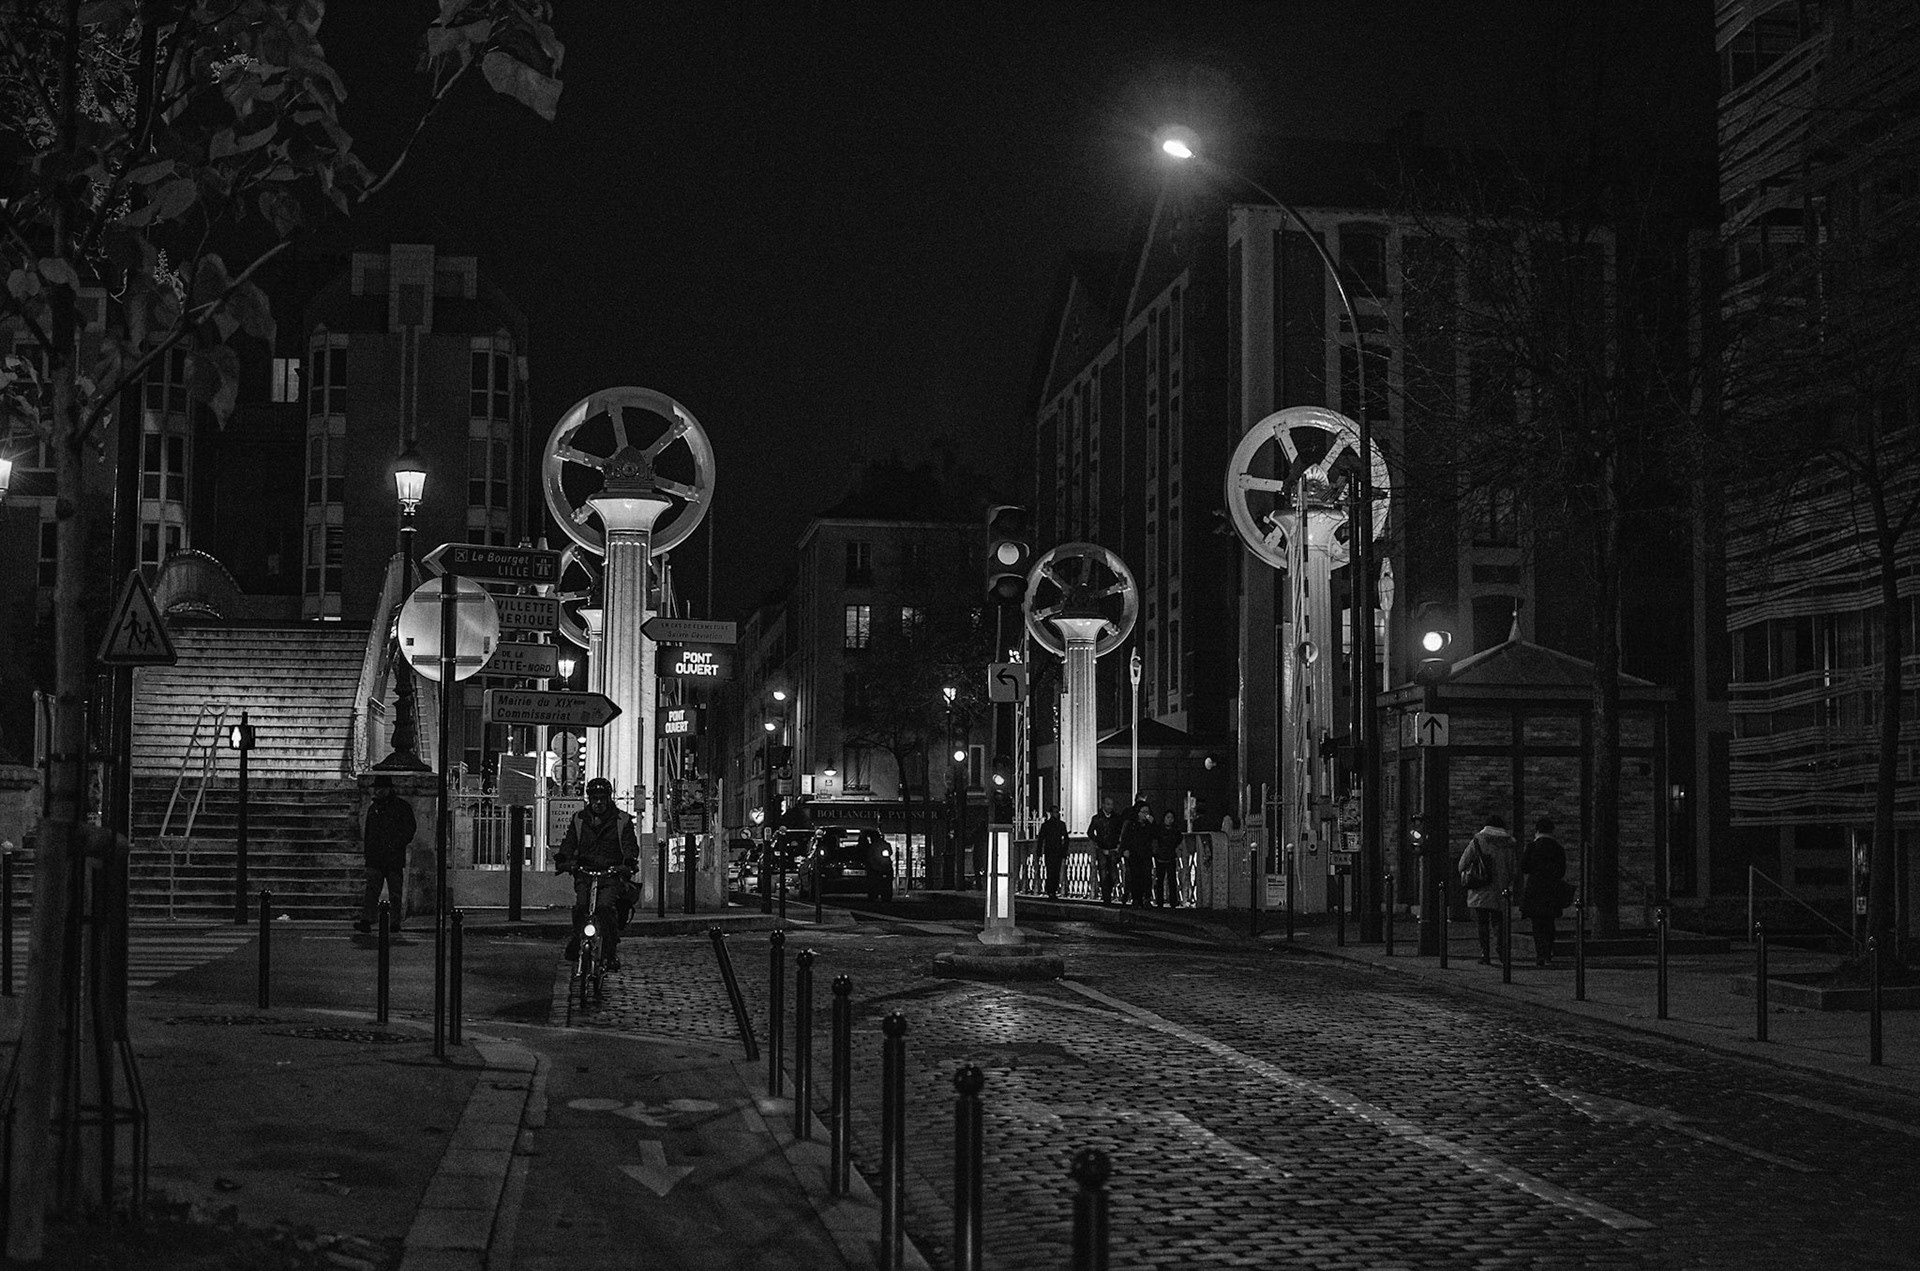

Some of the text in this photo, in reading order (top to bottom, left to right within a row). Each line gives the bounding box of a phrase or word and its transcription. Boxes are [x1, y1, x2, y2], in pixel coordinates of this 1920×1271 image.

[471, 551, 529, 566] Le Bourget
[498, 565, 529, 577] LILLE
[496, 600, 554, 613] VILLETTE
[498, 612, 554, 626] HERIQUE
[667, 630, 690, 638] Suivre
[682, 651, 713, 664] PONT
[487, 659, 552, 673] LETTE-NORD
[675, 662, 720, 676] OUVERT
[498, 695, 532, 706] Mairie
[538, 697, 550, 707] du
[497, 707, 571, 720] Commissariat
[668, 709, 685, 722] PONT
[665, 720, 689, 734] OUVERT
[887, 810, 938, 819] PATSSIR
